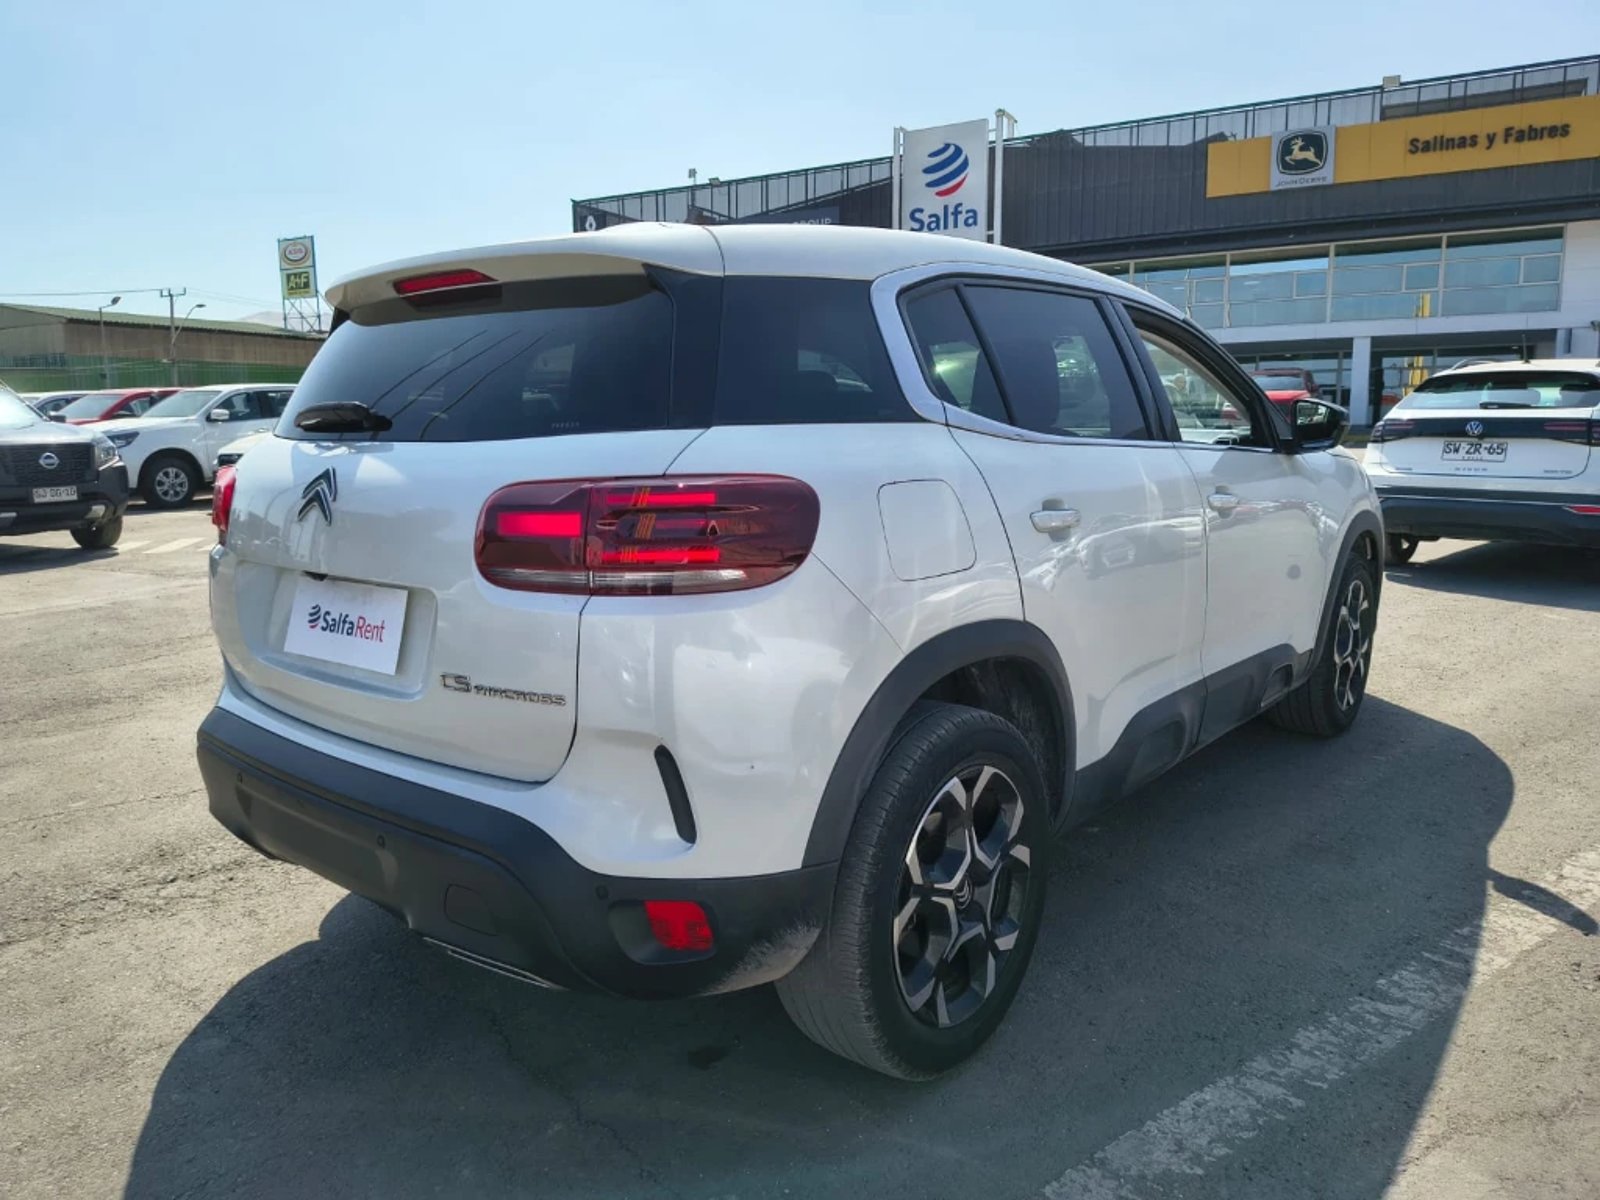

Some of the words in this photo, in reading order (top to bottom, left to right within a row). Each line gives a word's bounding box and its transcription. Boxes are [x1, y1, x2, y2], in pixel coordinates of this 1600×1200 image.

[1408, 134, 1479, 155] Salinas
[1486, 131, 1497, 150] y
[1503, 123, 1571, 145] Fabres
[909, 202, 978, 232] Salfa
[321, 610, 385, 643] SalfaRent
